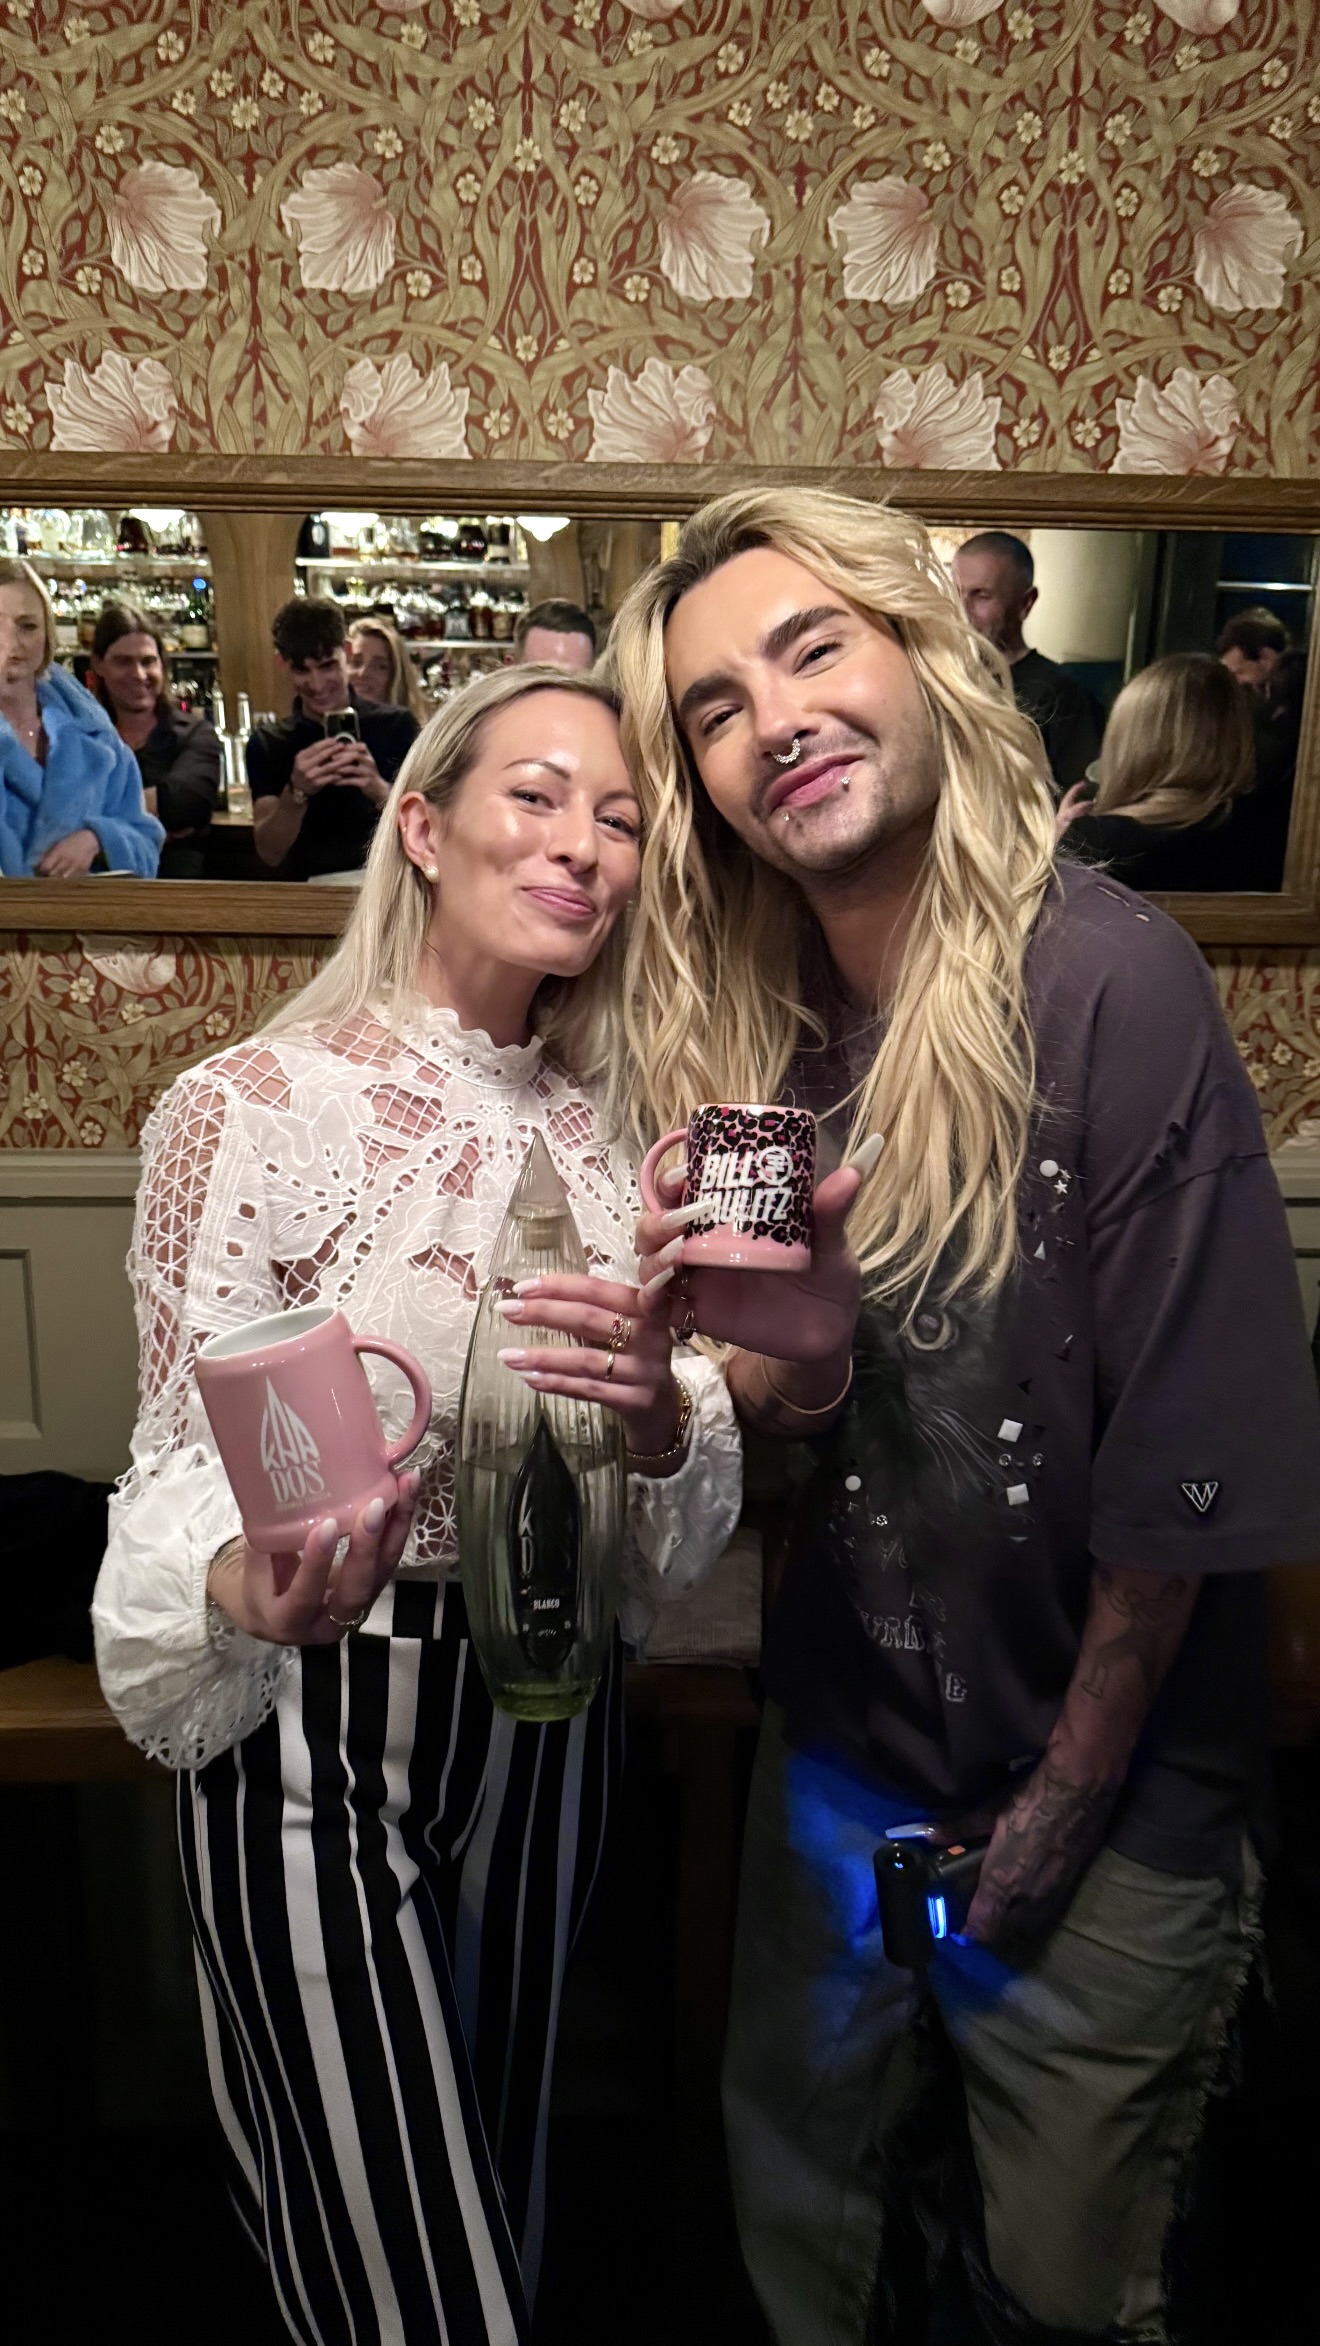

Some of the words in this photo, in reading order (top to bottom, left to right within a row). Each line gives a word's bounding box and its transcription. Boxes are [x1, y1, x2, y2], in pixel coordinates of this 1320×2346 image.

[700, 1151, 754, 1190] BILL
[269, 1460, 325, 1503] DOS
[533, 1598, 560, 1610] BLANCO
